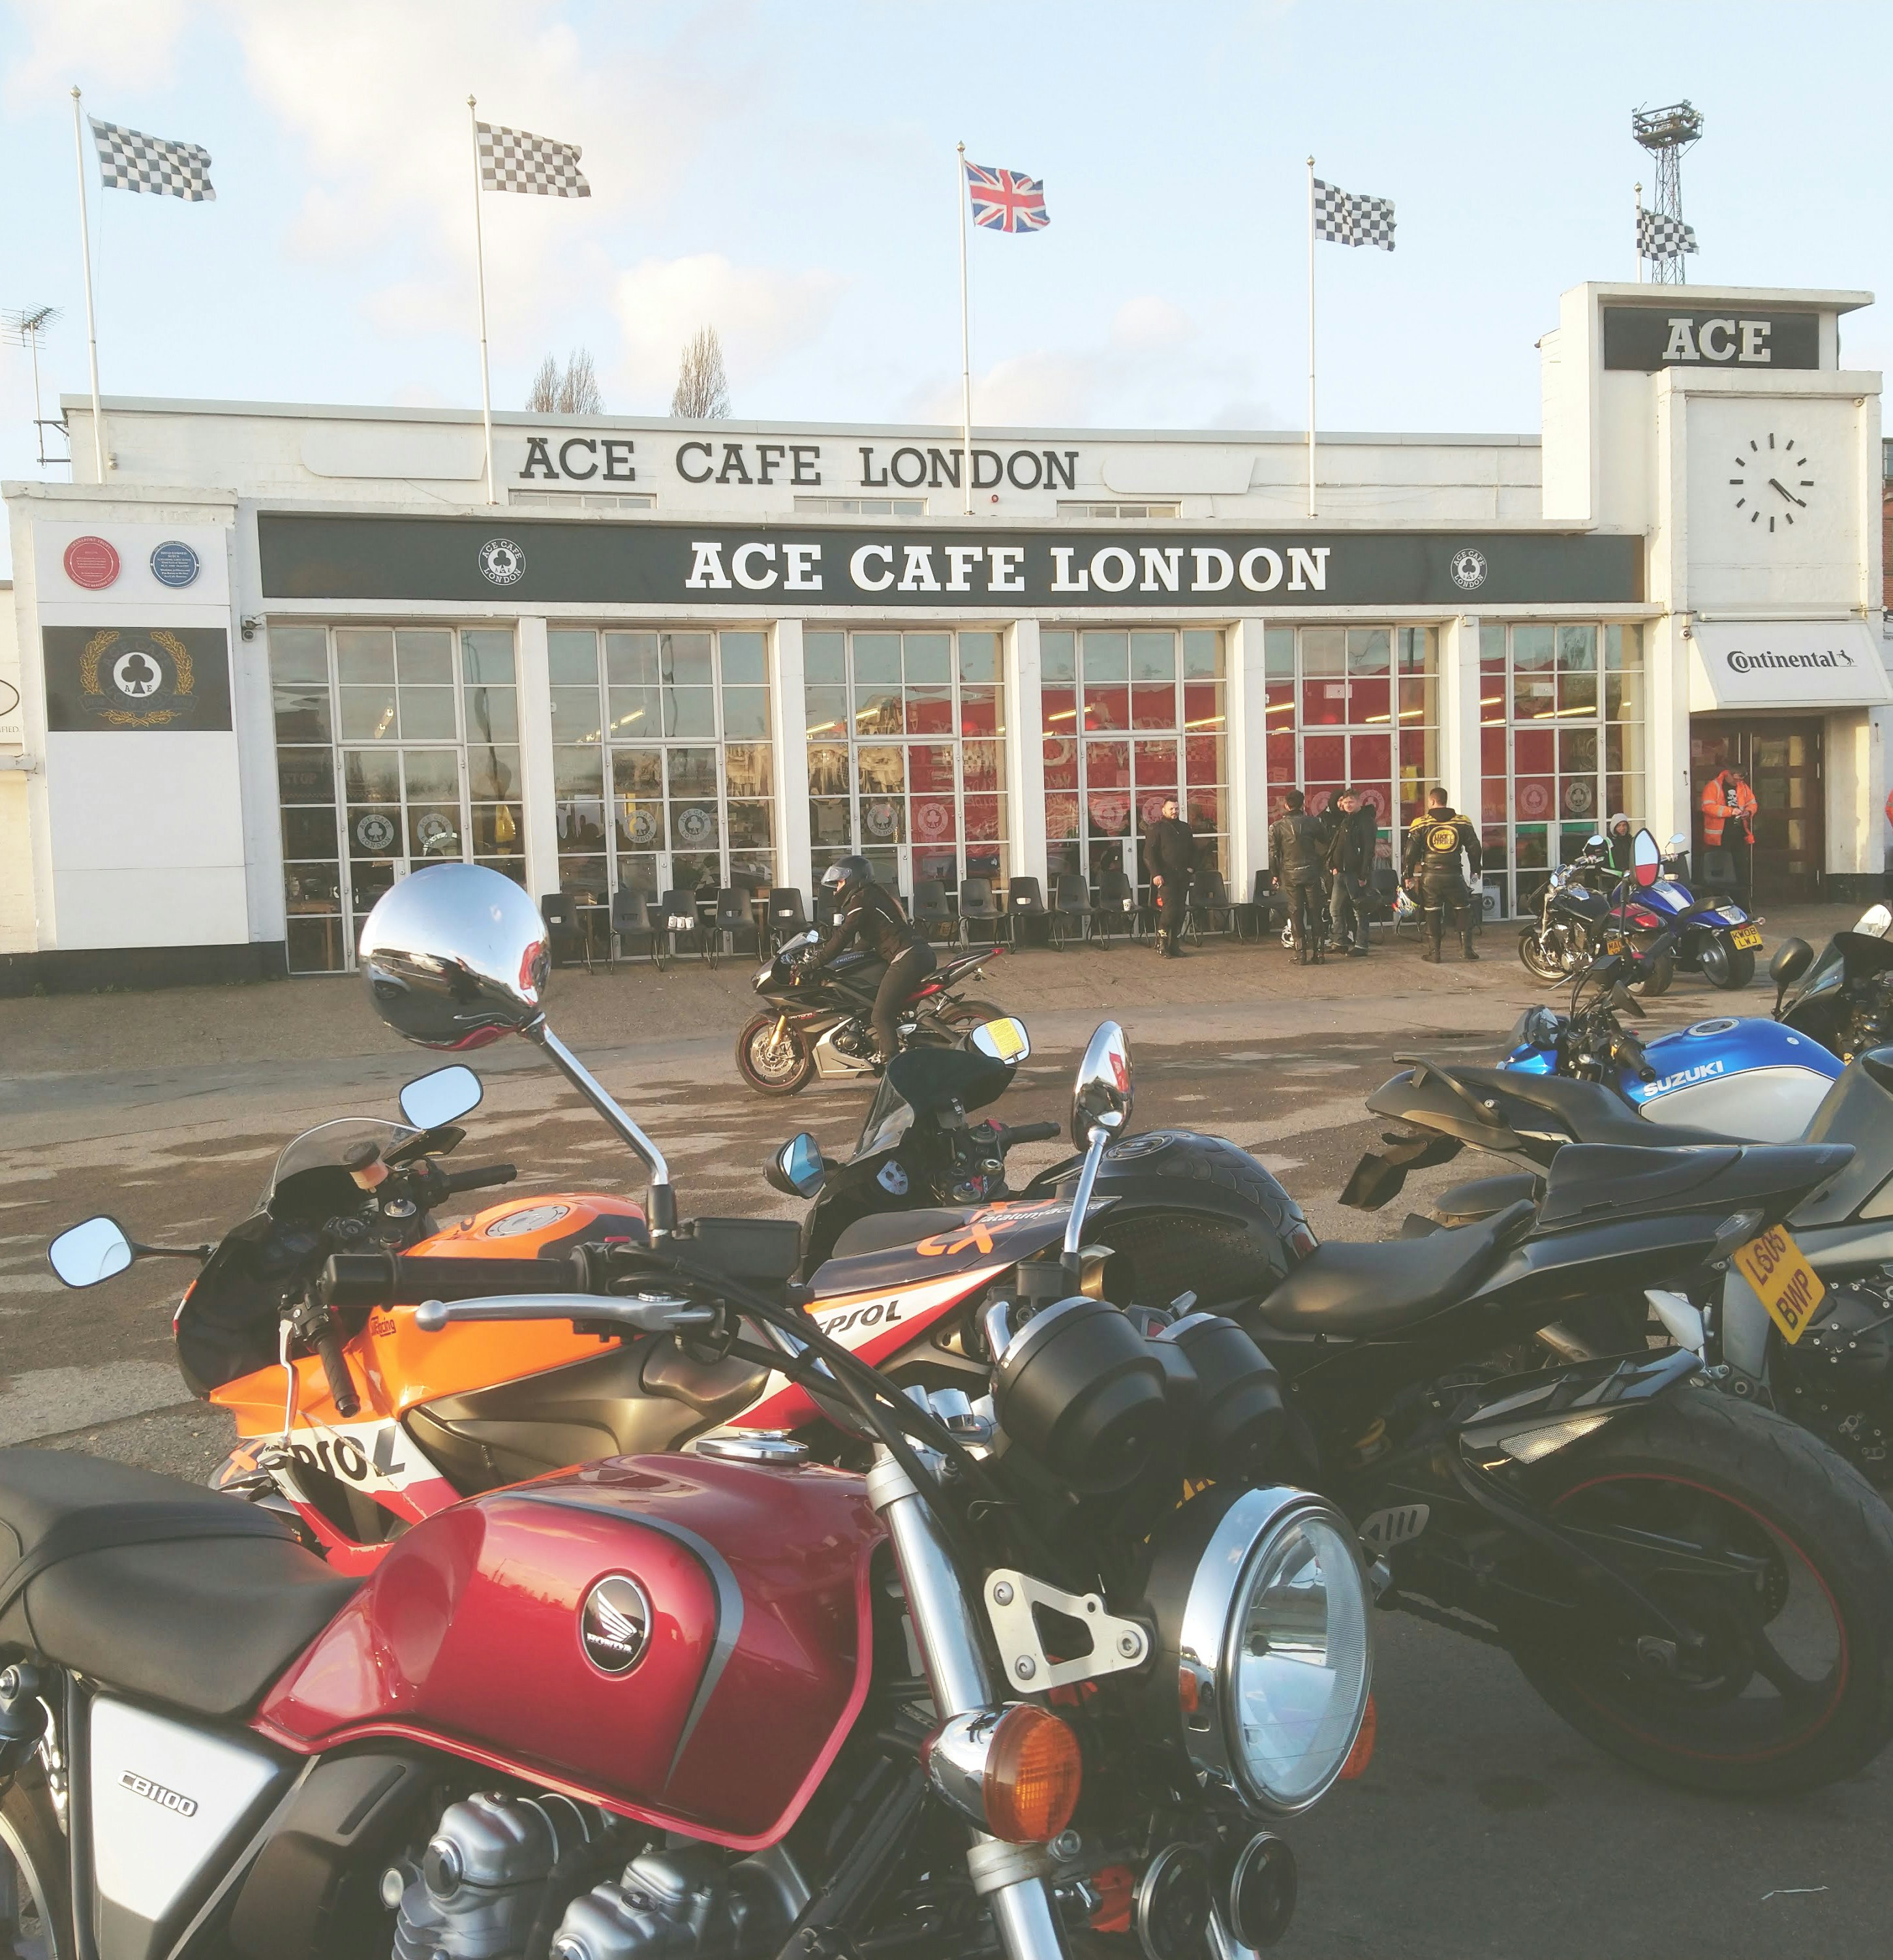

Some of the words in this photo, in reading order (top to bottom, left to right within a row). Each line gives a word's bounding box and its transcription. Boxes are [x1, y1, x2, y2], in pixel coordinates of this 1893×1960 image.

[1663, 318, 1770, 361] ACE
[519, 437, 635, 480] ACE
[676, 442, 821, 485] CAFE
[859, 448, 1079, 489] LONDON
[482, 542, 498, 559] ACE
[500, 541, 522, 559] CAFE
[1454, 551, 1467, 566] ACE
[1468, 551, 1485, 566] CAFE
[484, 568, 521, 583] LONDON
[685, 542, 822, 590] ACE
[850, 545, 1024, 591] CAFE
[1051, 547, 1331, 592] LONDON
[1454, 574, 1483, 587] LONDON
[1727, 651, 1839, 673] Continental
[362, 836, 391, 848] LONDON
[1732, 927, 1757, 940] KW08
[1738, 936, 1757, 947] LWJ
[836, 954, 865, 964] TRIUMPH
[1644, 1060, 1724, 1097] SUZUKI
[1776, 1268, 1812, 1330] BWP
[587, 1632, 633, 1654] HONDA
[117, 1770, 196, 1816] CB1100
